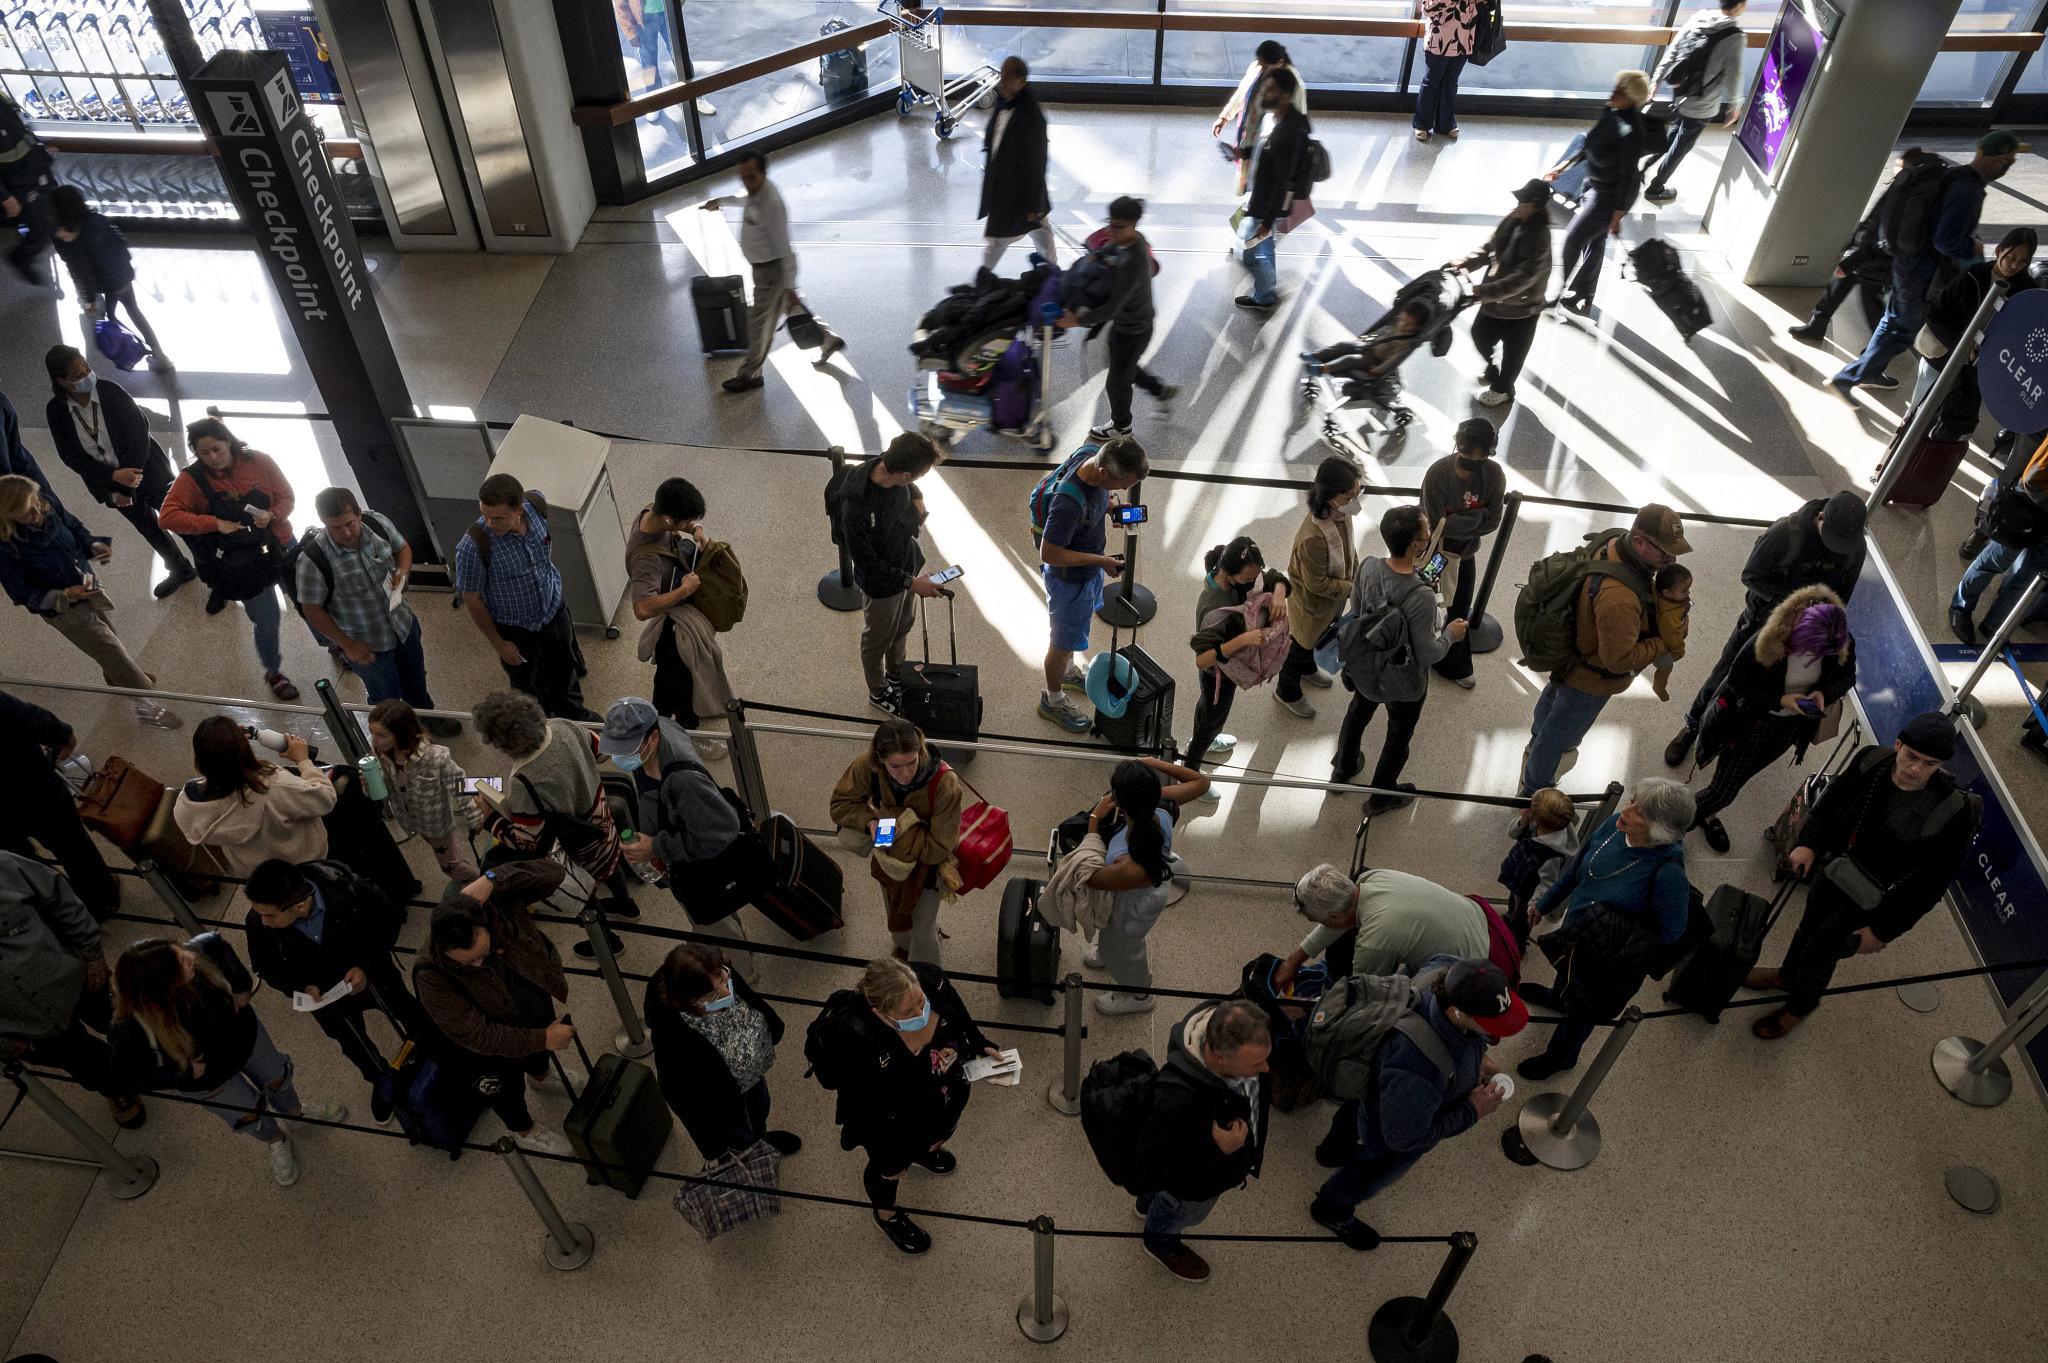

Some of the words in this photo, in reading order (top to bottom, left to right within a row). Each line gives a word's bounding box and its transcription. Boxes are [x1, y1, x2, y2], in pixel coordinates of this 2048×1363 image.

[239, 148, 328, 321] Checkpoint
[291, 129, 362, 311] Checkpoint
[1999, 348, 2043, 402] CLEAR
[2020, 390, 2035, 410] PLUS
[1978, 853, 2015, 919] CLEAR
